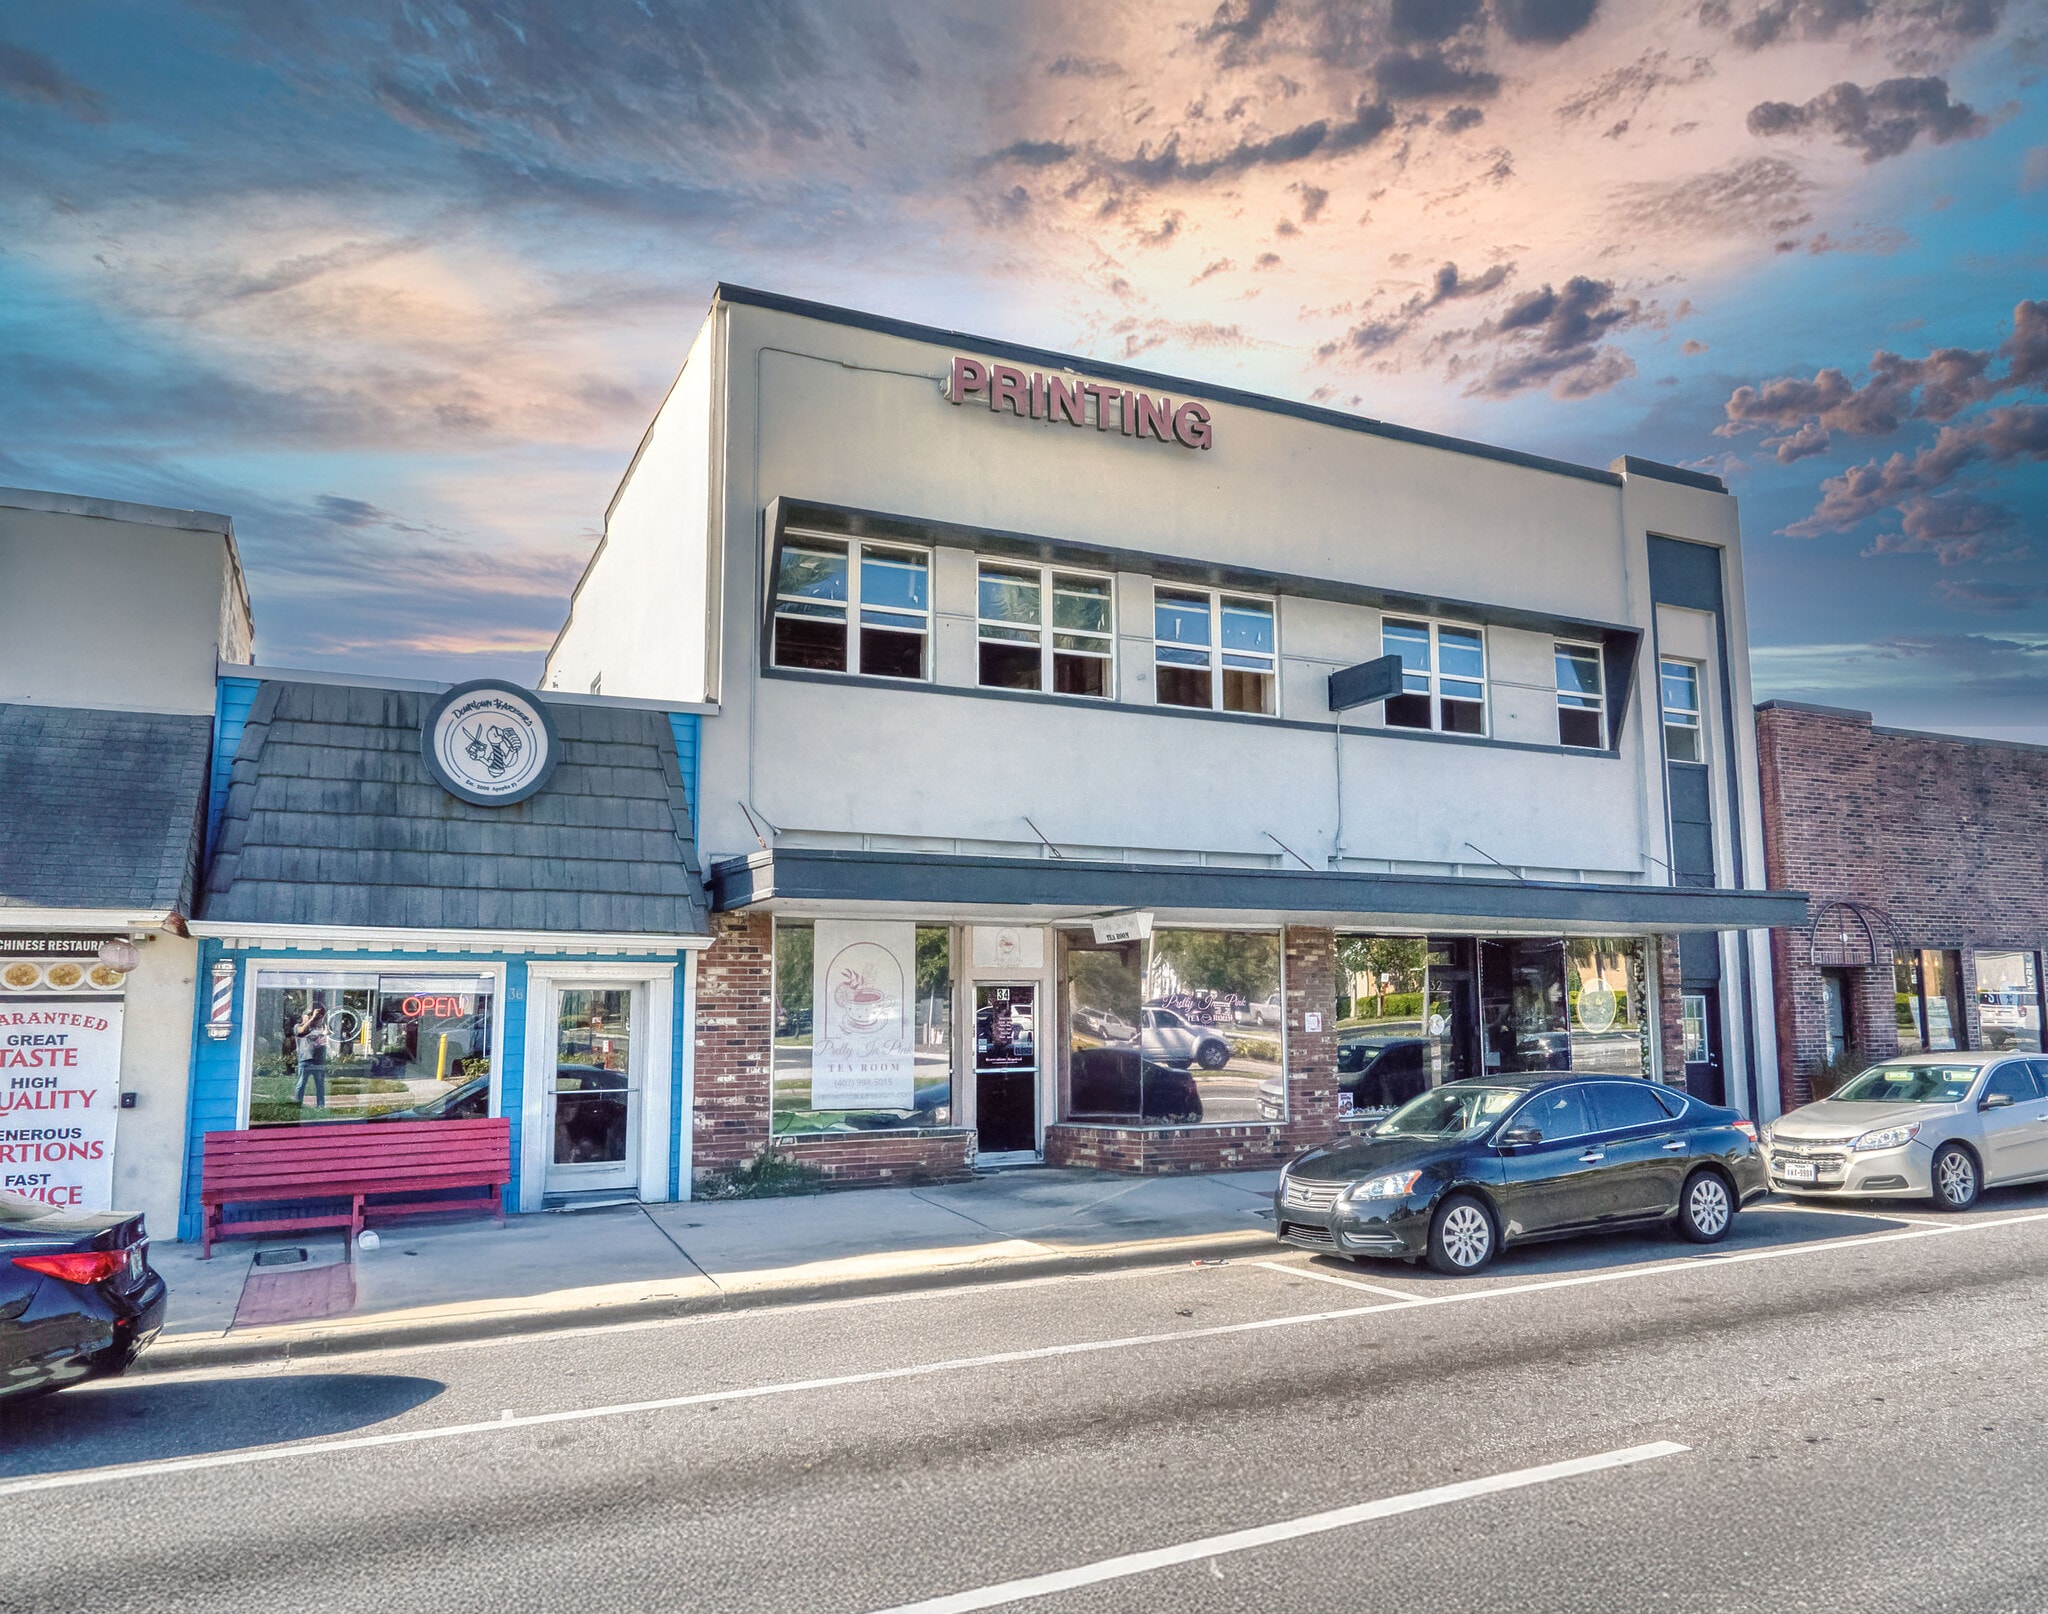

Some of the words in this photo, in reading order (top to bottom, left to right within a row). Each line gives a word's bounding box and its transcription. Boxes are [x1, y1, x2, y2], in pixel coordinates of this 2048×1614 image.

[951, 356, 1212, 450] PRINTING
[1116, 932, 1130, 940] ROOM
[47, 941, 109, 951] RESTAURA
[1430, 981, 1442, 990] 32
[508, 987, 524, 1000] 36
[998, 989, 1009, 1000] 34
[402, 996, 464, 1017] OPEN
[1162, 993, 1193, 1012] Pretty
[1225, 993, 1246, 1006] Pink
[7, 1034, 69, 1046] GREAT
[815, 1040, 853, 1061] Pretty
[0, 1048, 78, 1067] TASTE
[829, 1064, 854, 1073] TEA
[861, 1063, 900, 1072] ROOM
[11, 1077, 57, 1089] HIGH
[0, 1089, 97, 1116] UALITY
[5, 1173, 51, 1186] FAST
[5, 1185, 83, 1208] VICE
